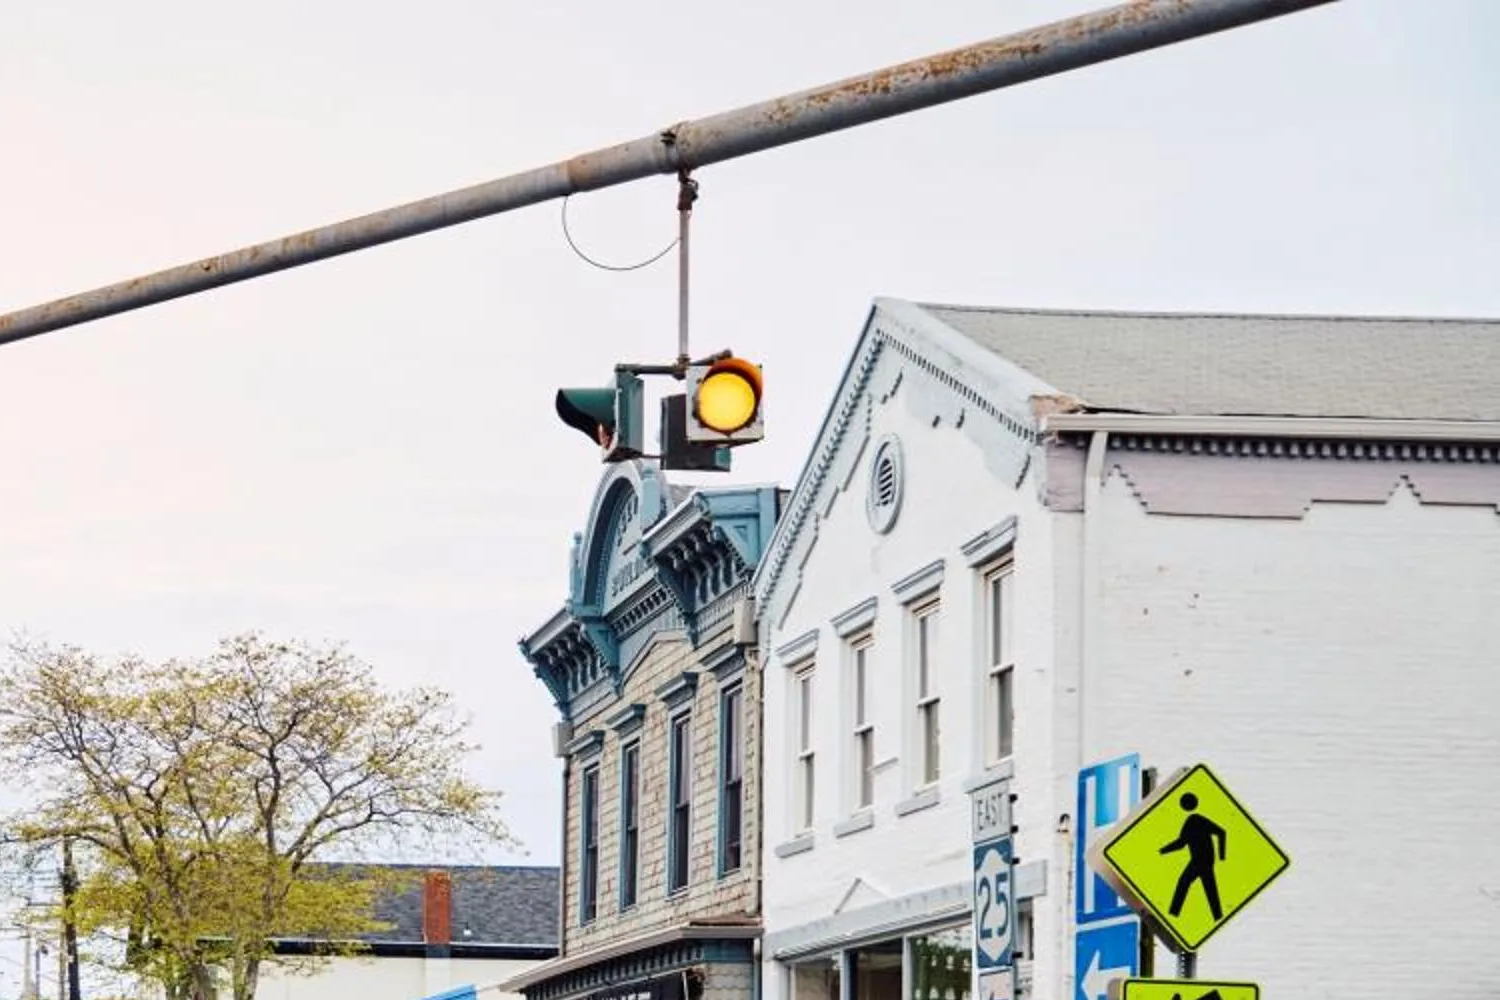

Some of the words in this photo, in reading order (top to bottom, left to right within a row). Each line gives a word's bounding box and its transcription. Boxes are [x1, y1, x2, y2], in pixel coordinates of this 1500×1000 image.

[977, 791, 1003, 832] EAST
[1084, 764, 1131, 914] H
[977, 871, 1009, 940] 25
